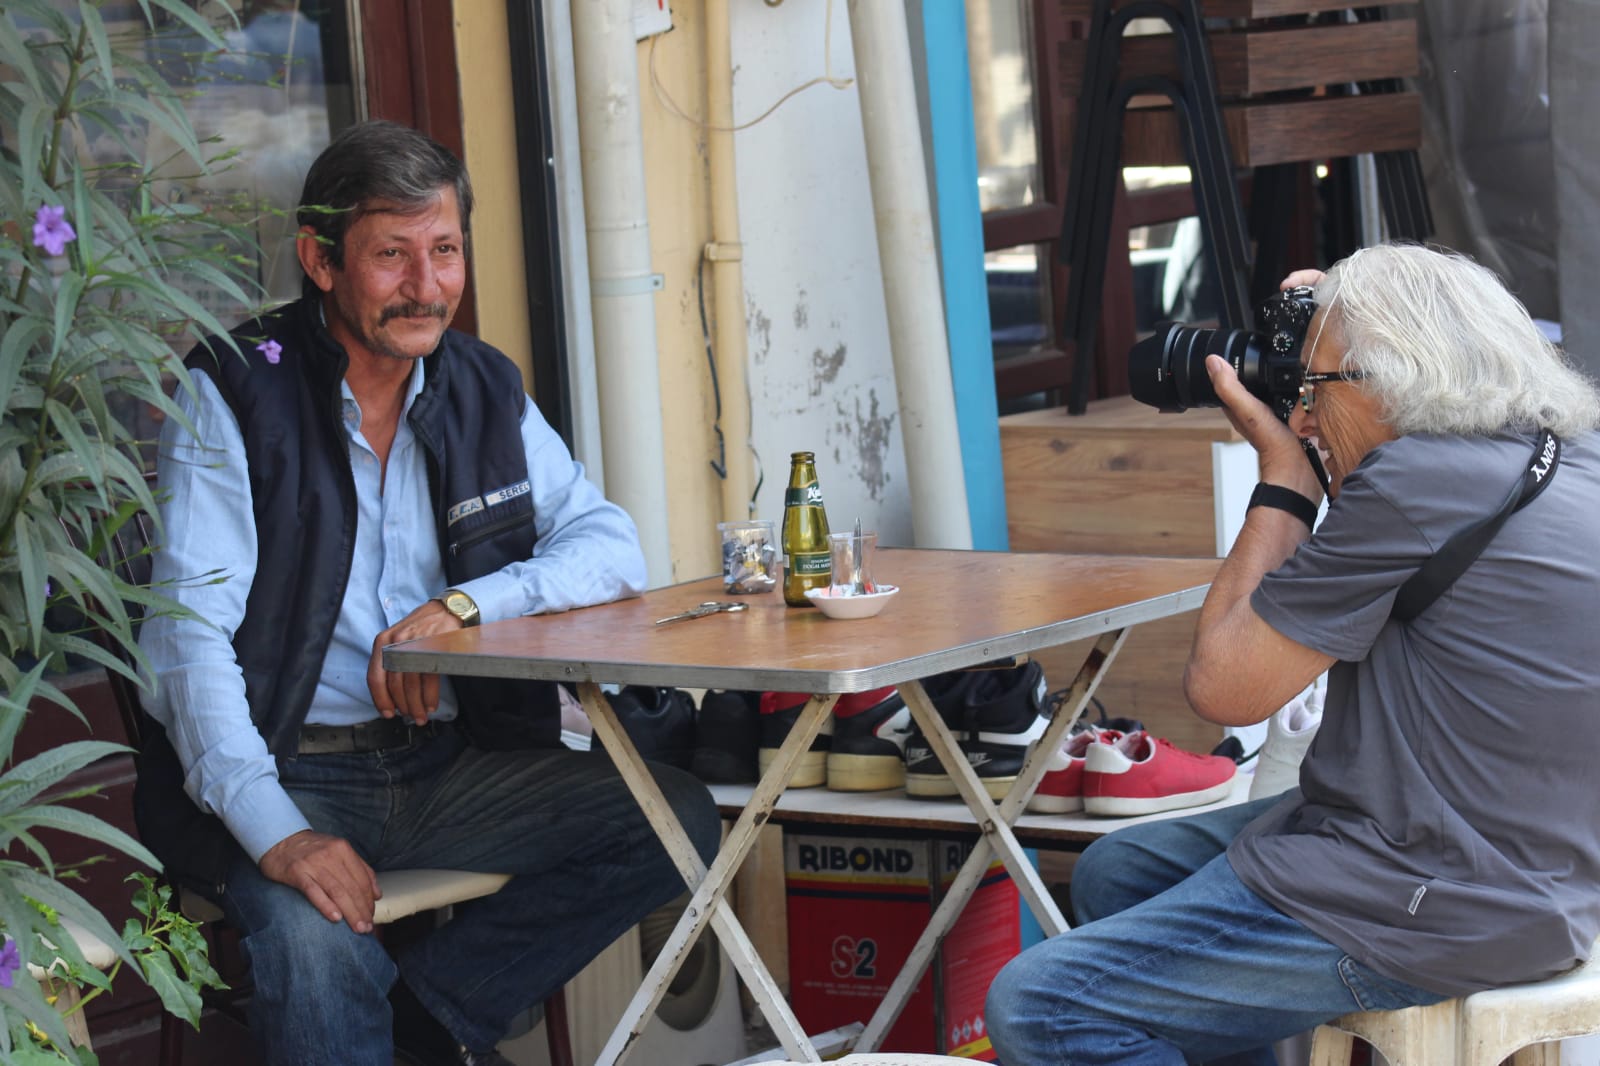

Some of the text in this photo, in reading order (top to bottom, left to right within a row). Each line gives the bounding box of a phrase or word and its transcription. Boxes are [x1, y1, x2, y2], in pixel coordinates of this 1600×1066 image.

[1530, 433, 1556, 483] SONY
[799, 844, 914, 873] RIBOND
[831, 935, 877, 978] S2
